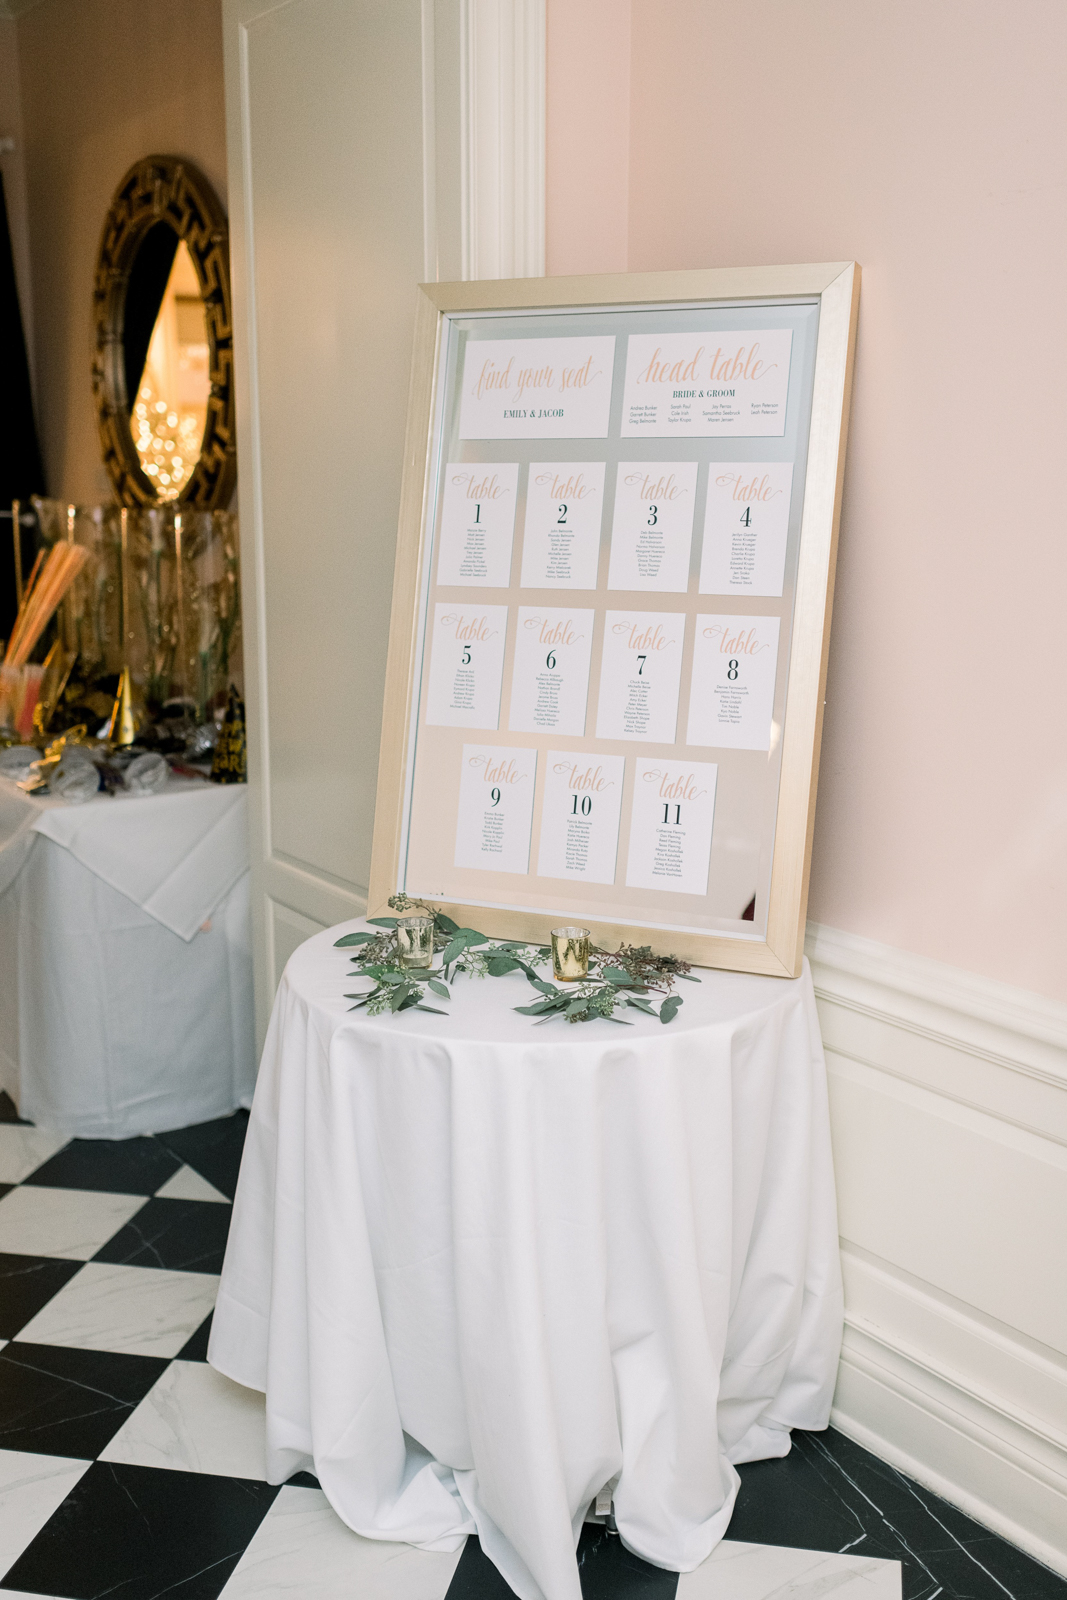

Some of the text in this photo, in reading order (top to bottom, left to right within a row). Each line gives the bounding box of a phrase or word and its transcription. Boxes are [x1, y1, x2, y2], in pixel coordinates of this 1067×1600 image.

[637, 342, 778, 385] head table
[471, 355, 602, 403] find your seat
[673, 390, 697, 399] BRIDE
[706, 389, 735, 398] GROOM
[503, 408, 564, 419] EMILY & JACOB
[452, 472, 510, 500] table
[535, 472, 596, 500] table
[624, 472, 688, 501] table
[716, 473, 782, 502] table
[474, 504, 481, 523] 1
[557, 504, 568, 524] 2
[647, 505, 658, 526] 3
[740, 506, 752, 527] 4
[441, 613, 498, 641] table
[524, 616, 584, 645] table
[612, 621, 675, 650] table
[703, 625, 770, 655] table
[462, 645, 471, 665] 5
[546, 649, 556, 669] 6
[637, 655, 647, 675] 7
[727, 659, 739, 680] 8
[469, 755, 528, 784] table
[553, 761, 614, 792] table
[643, 769, 707, 800] table
[491, 788, 501, 808] 9
[571, 795, 592, 816] 10
[662, 803, 682, 825] 11
